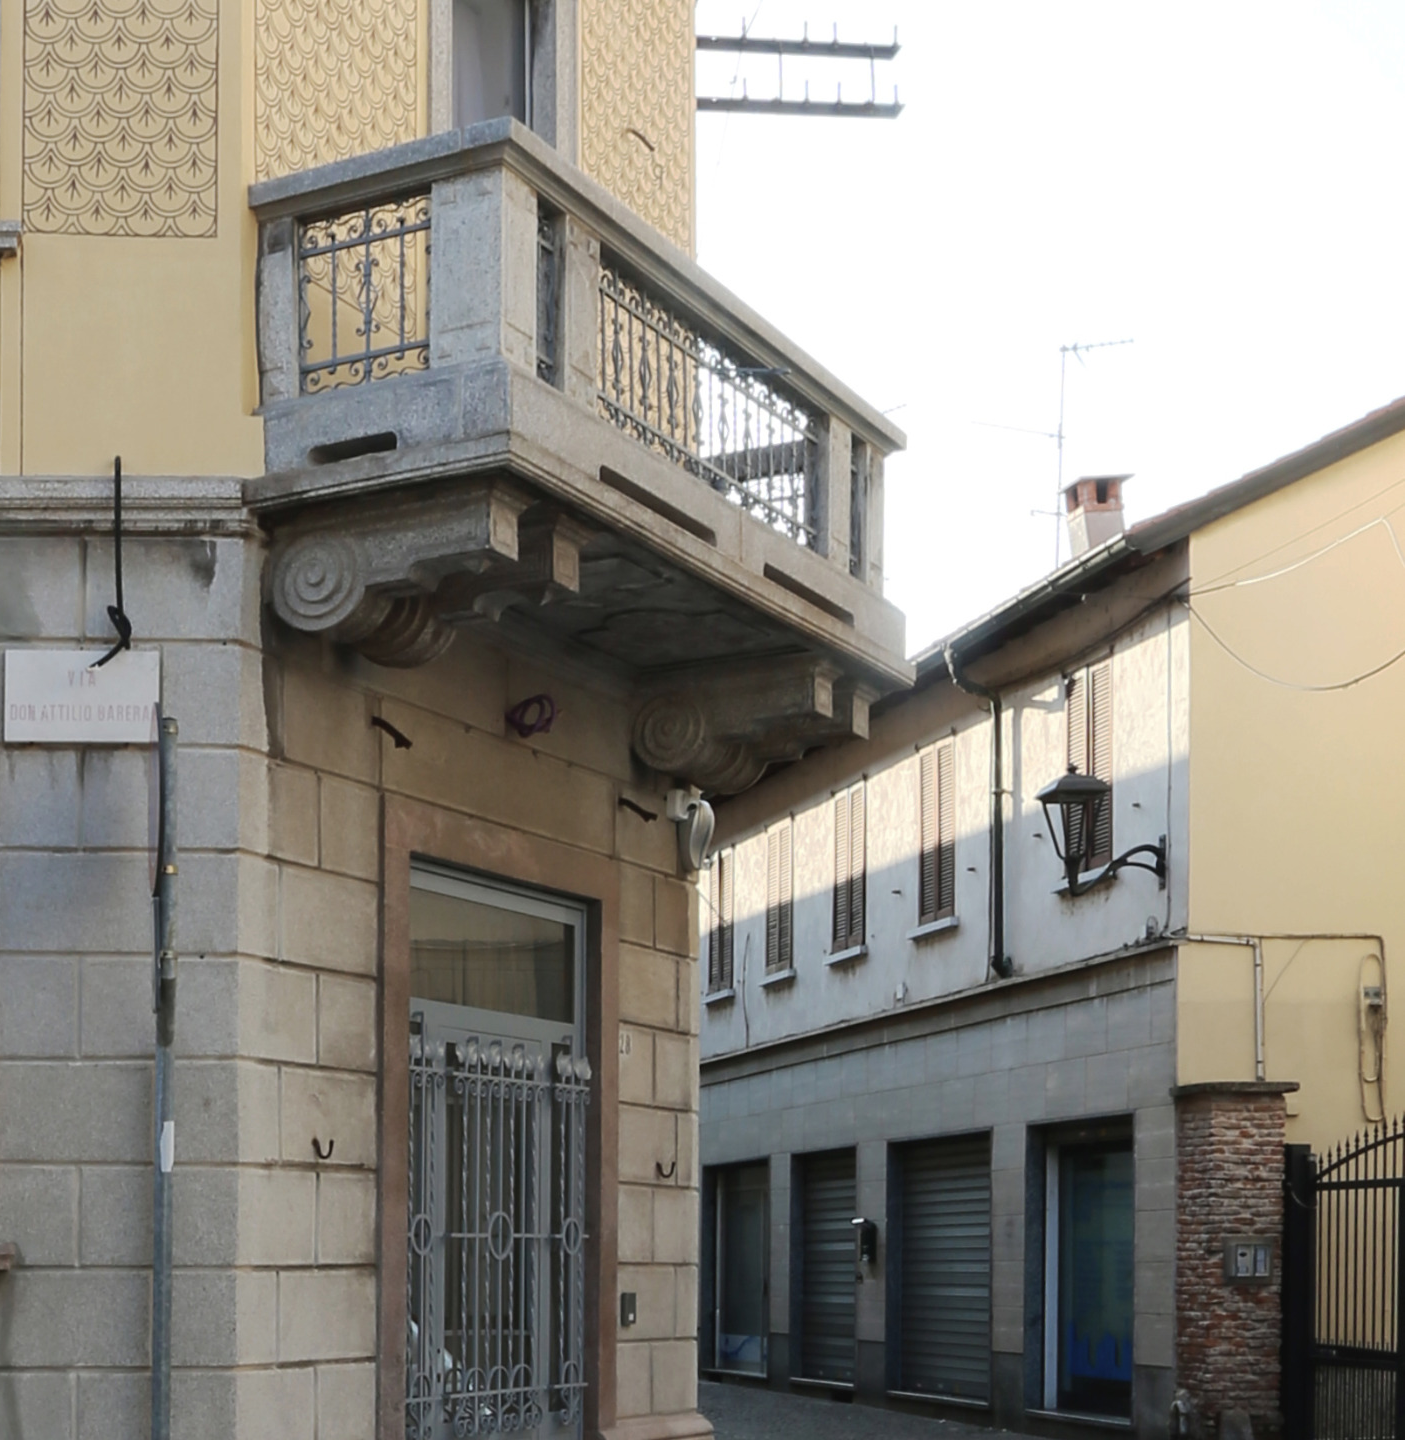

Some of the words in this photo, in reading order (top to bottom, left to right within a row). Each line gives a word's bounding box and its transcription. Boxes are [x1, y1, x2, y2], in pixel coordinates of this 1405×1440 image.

[67, 669, 96, 687] VIA
[9, 703, 36, 721] DON
[40, 703, 92, 722] ATTILIO
[97, 704, 150, 722] BARERA
